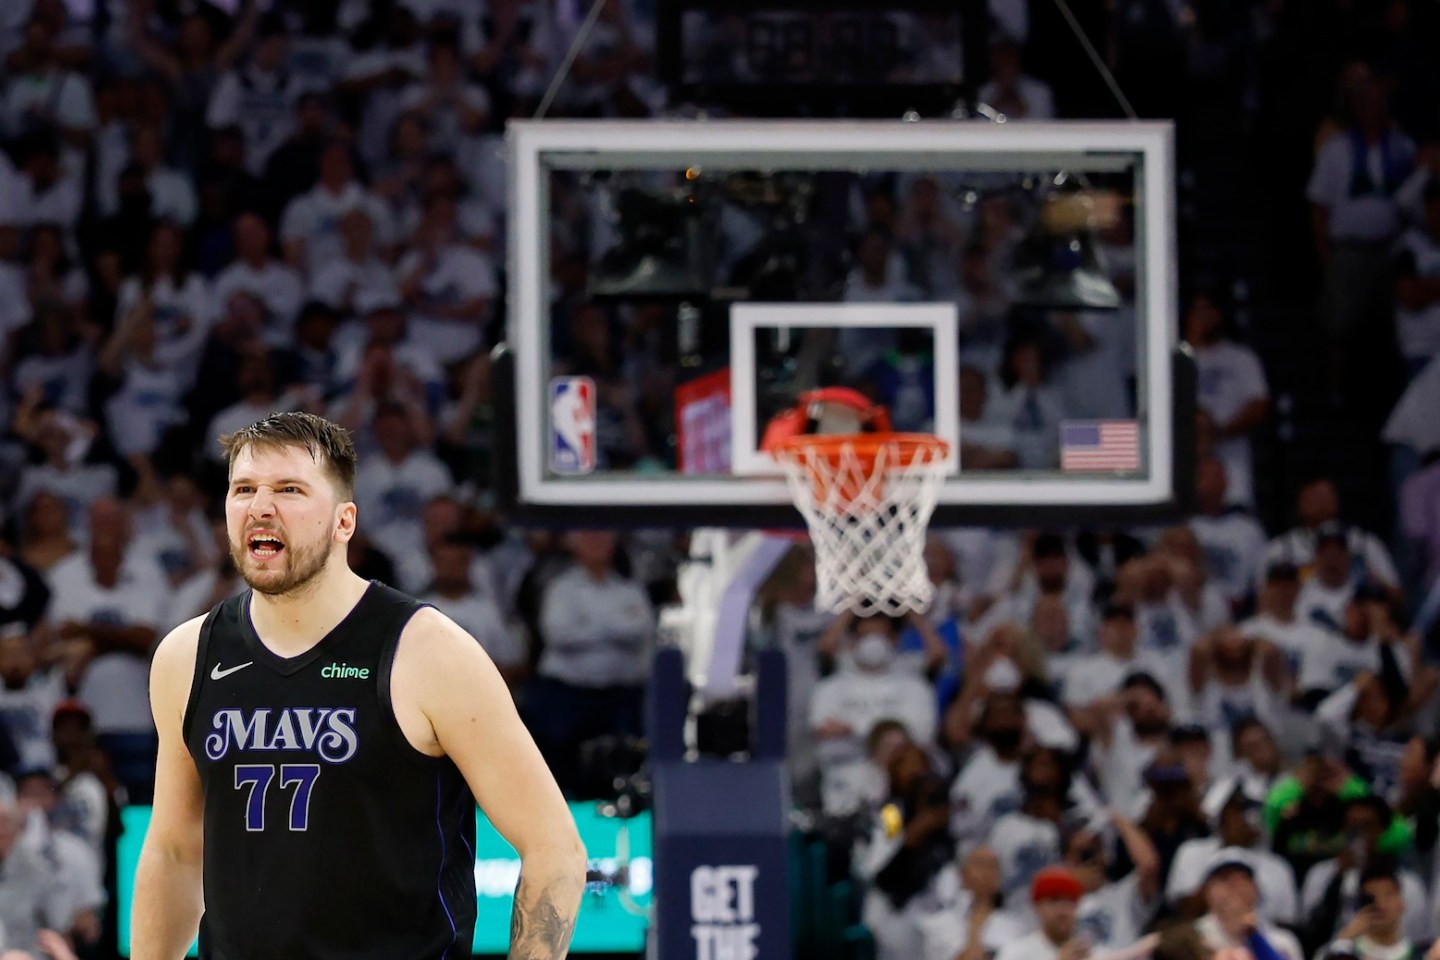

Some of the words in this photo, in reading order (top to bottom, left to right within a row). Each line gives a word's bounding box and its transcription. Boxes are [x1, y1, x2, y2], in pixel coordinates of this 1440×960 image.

[321, 662, 370, 680] chime
[205, 708, 359, 764] MAVS
[234, 764, 321, 832] 77
[690, 864, 759, 923] GET
